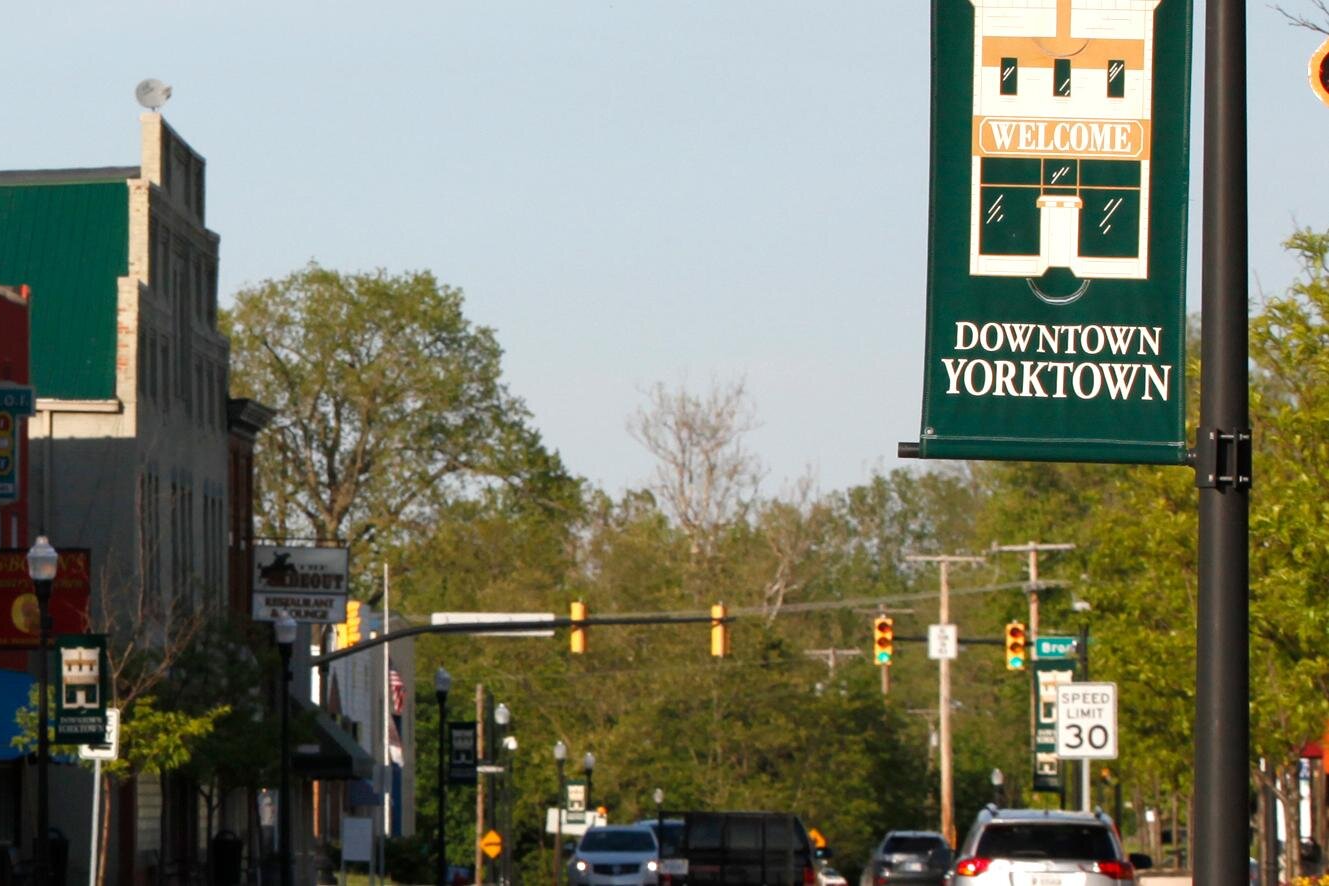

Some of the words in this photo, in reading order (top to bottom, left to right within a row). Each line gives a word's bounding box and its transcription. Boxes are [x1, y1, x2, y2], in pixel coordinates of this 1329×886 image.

[988, 121, 1132, 152] WELCOME
[954, 321, 1162, 355] DOWNTOWN
[941, 358, 1172, 401] YORKTOWN
[1061, 693, 1110, 705] SPEED
[1067, 708, 1104, 719] LIMIT
[1065, 724, 1109, 749] 30
